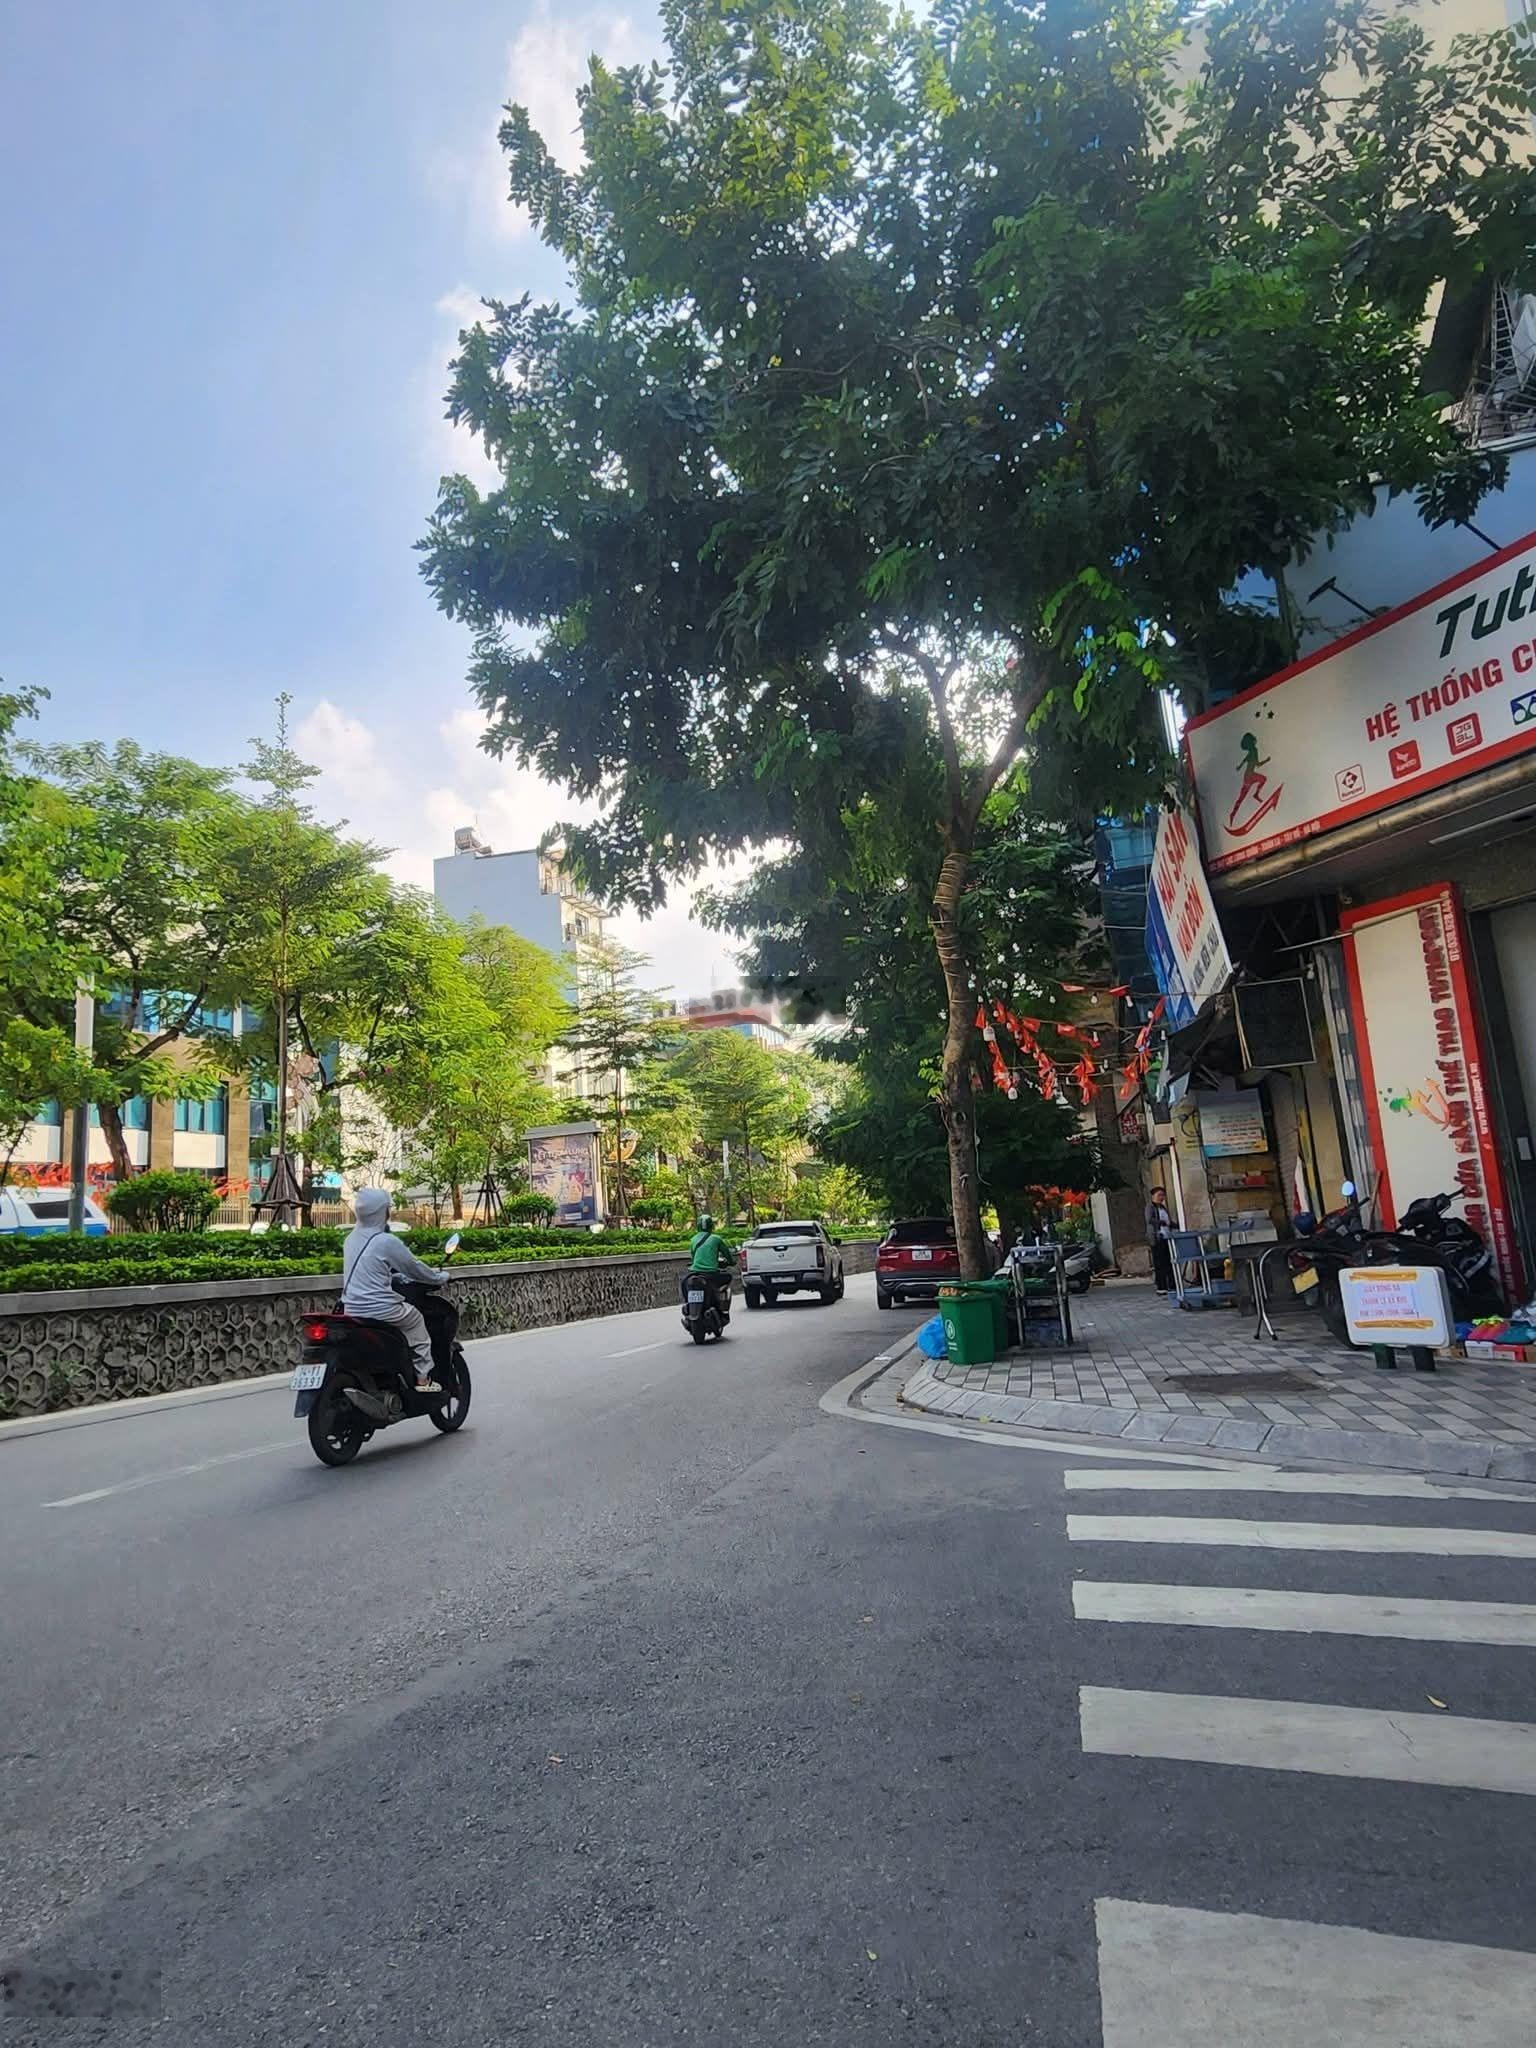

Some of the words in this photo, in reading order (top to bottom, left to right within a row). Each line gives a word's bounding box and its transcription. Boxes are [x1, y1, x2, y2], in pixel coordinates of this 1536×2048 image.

[1436, 564, 1536, 659] Tut
[1366, 702, 1401, 742] HỆ
[1406, 666, 1503, 722] THỐNG
[1512, 638, 1536, 673] C
